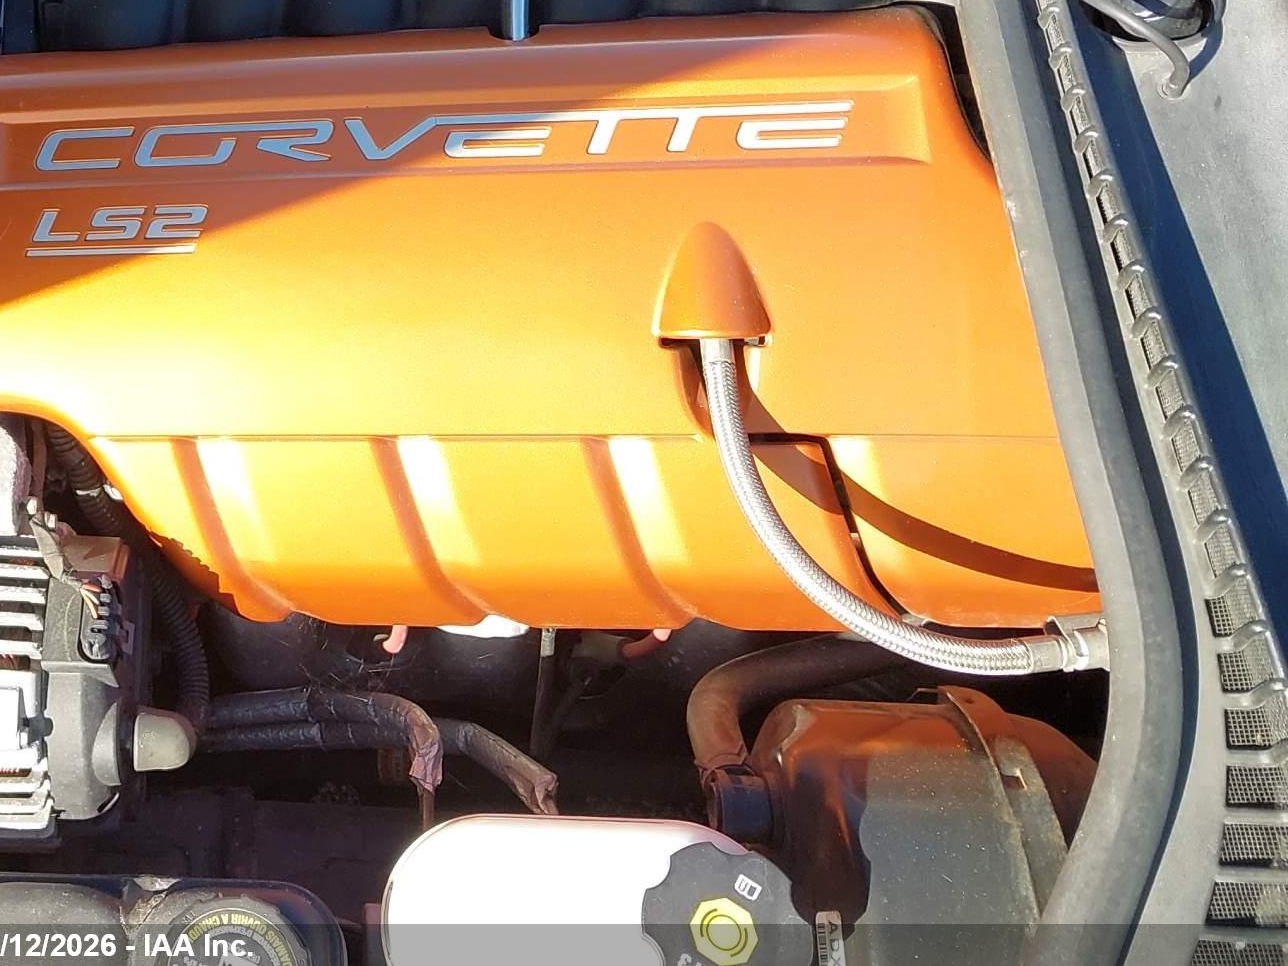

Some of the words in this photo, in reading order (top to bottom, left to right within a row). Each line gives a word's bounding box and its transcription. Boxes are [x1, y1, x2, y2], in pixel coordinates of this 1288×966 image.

[34, 100, 854, 171] CORVETTE
[32, 203, 210, 243] LS2
[231, 913, 268, 935] OUVRIR
